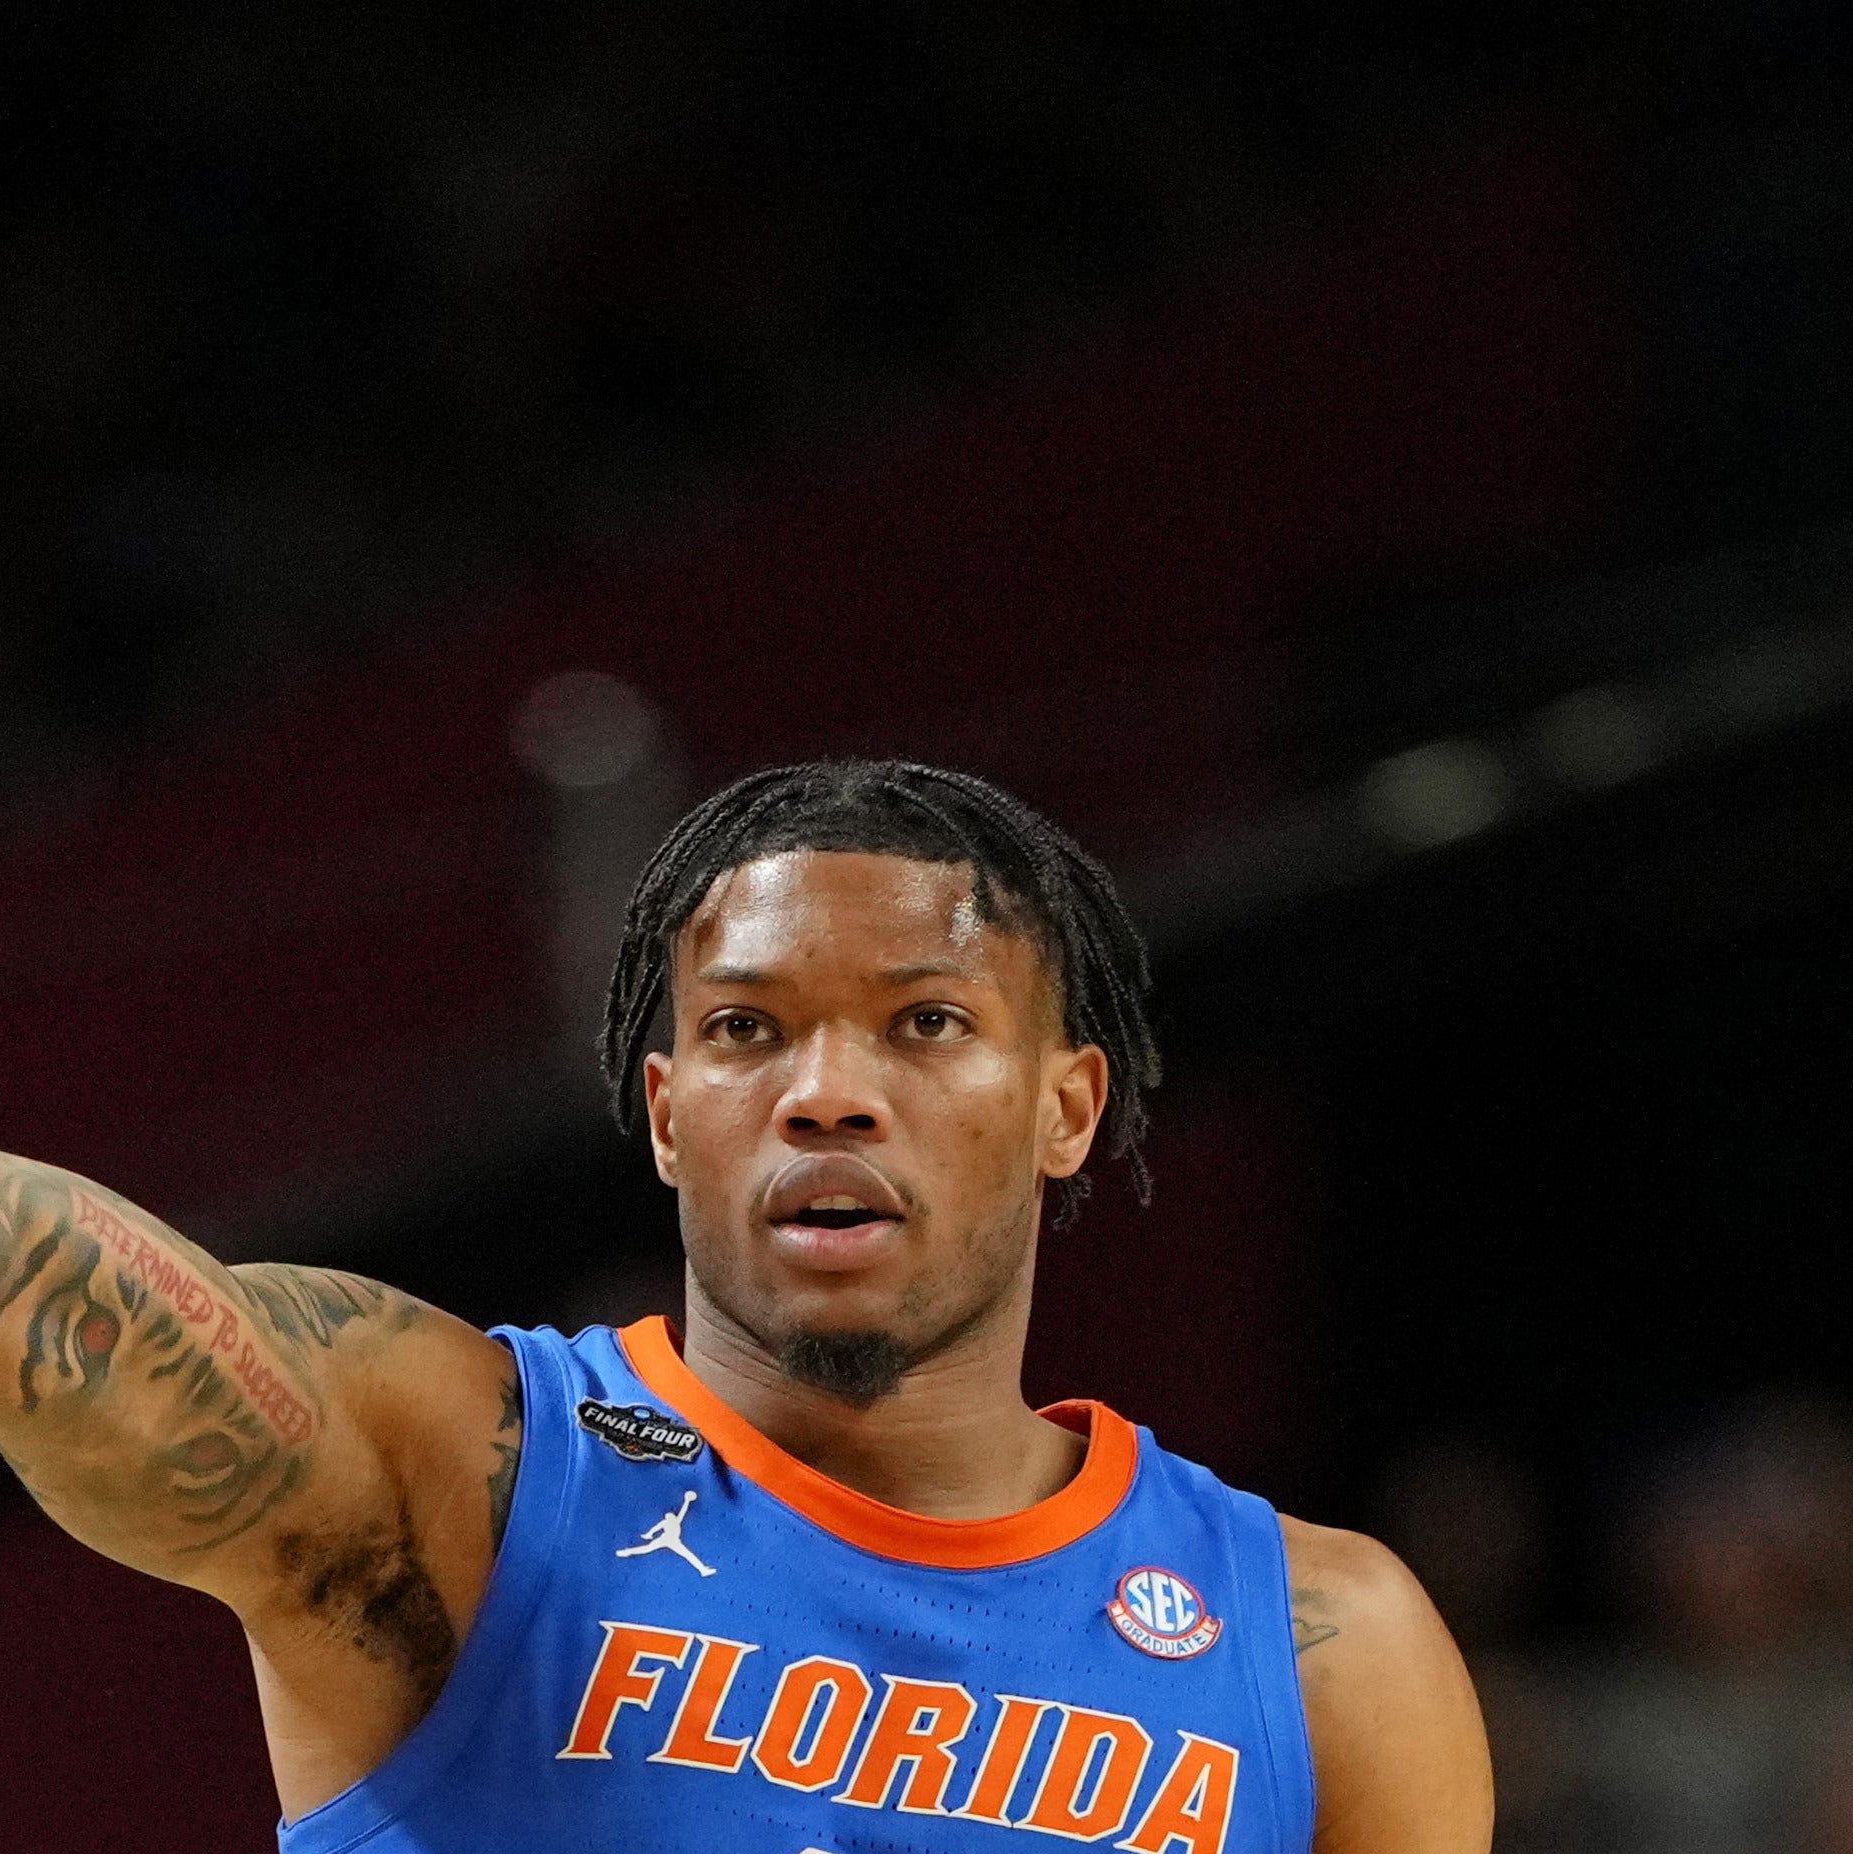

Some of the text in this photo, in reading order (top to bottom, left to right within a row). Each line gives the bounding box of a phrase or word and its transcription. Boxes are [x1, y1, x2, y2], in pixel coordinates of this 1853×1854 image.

[77, 1190, 215, 1325] DETERMINED
[209, 1301, 240, 1353] TO
[584, 1406, 637, 1436] FINAL
[639, 1425, 697, 1449] FOUR
[1126, 1570, 1197, 1634] SEC
[1121, 1618, 1207, 1655] GRADUATE
